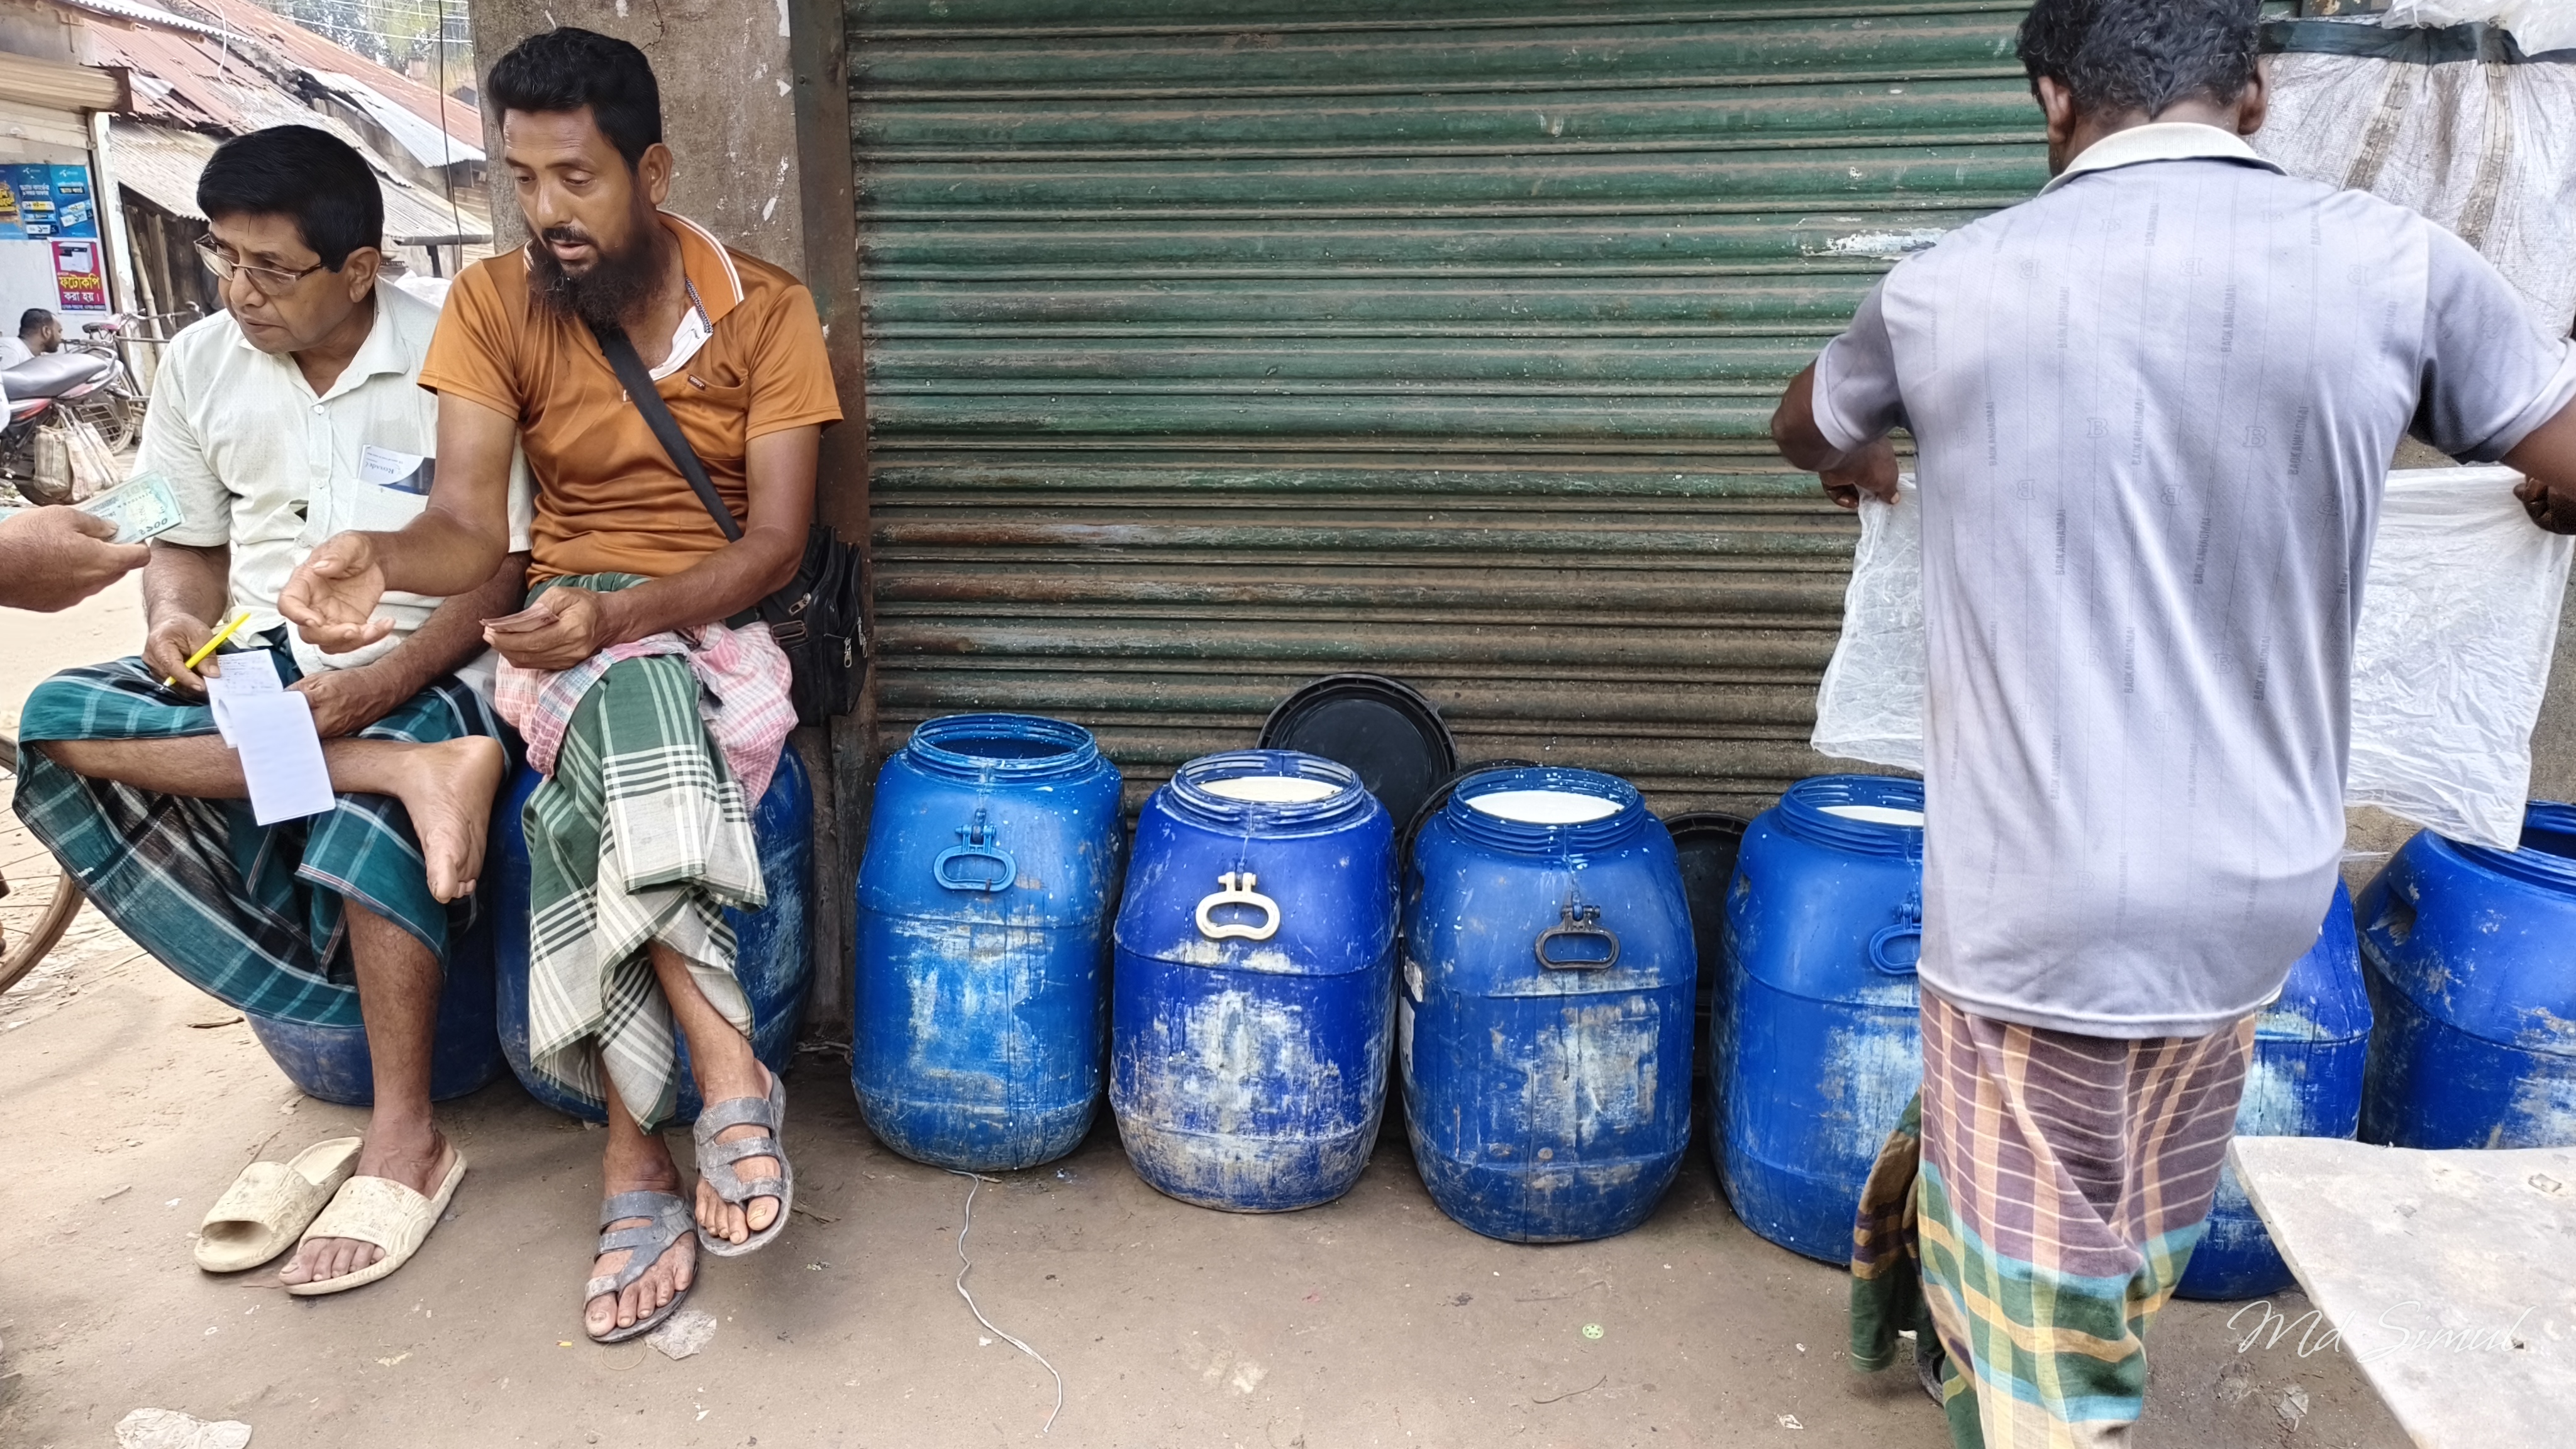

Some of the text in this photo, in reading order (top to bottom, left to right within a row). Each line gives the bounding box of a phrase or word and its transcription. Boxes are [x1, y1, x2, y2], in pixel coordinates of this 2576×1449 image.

[58, 273, 100, 289] ফটোকপি
[63, 291, 80, 301] করা
[1985, 401, 1997, 467] BAOKANHAOMAI
[2055, 509, 2066, 575] BAOKANHAOMAI
